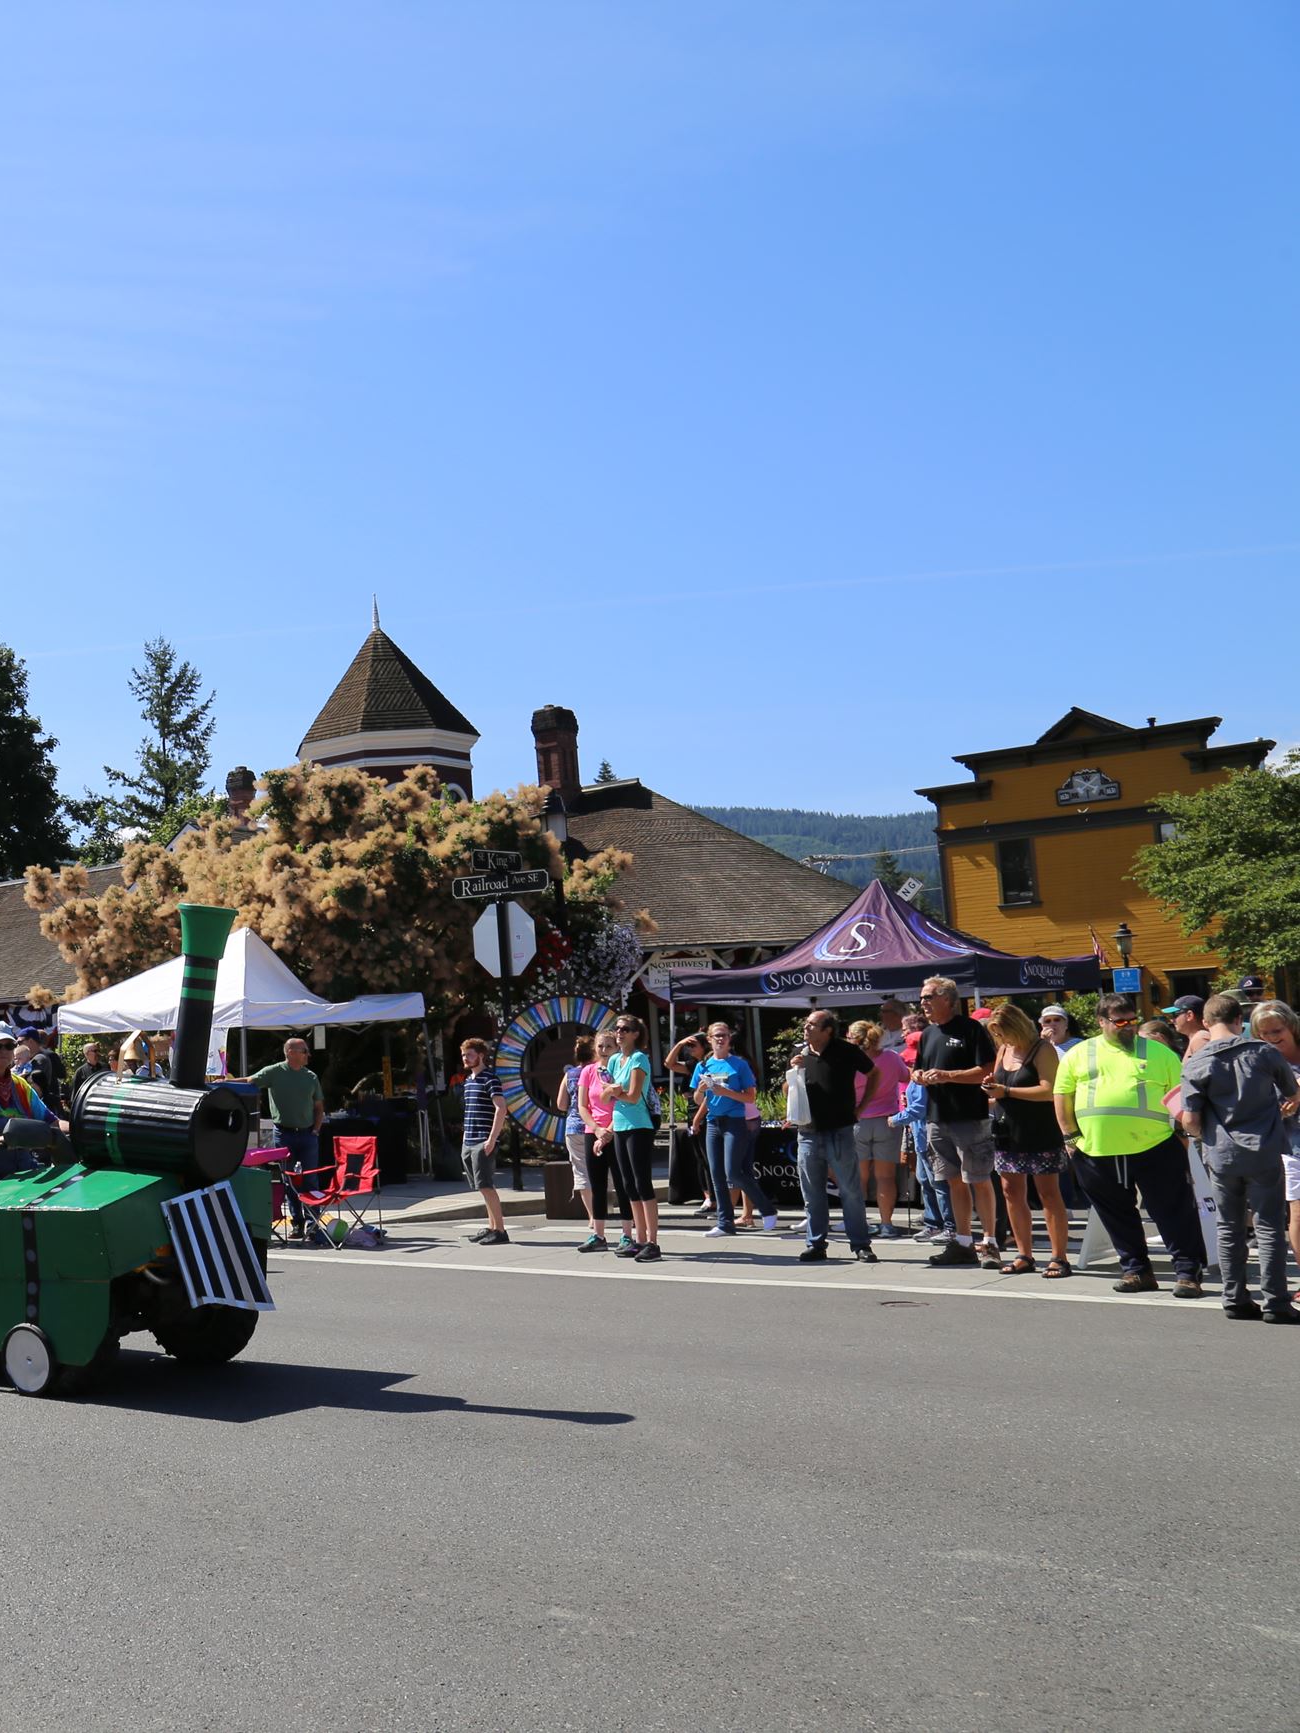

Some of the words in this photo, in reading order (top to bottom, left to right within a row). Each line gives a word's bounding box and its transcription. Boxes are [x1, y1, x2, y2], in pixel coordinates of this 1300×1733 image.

[488, 853, 508, 869] King
[461, 876, 509, 896] Railroad
[512, 876, 526, 884] Ave
[527, 873, 539, 883] SE
[650, 961, 711, 970] NORTHWEST
[1023, 961, 1067, 979] SNOQUALMIE
[769, 970, 871, 990] SNOQUALMIE
[828, 983, 872, 993] CASINO
[752, 1161, 800, 1180] SNOQ
